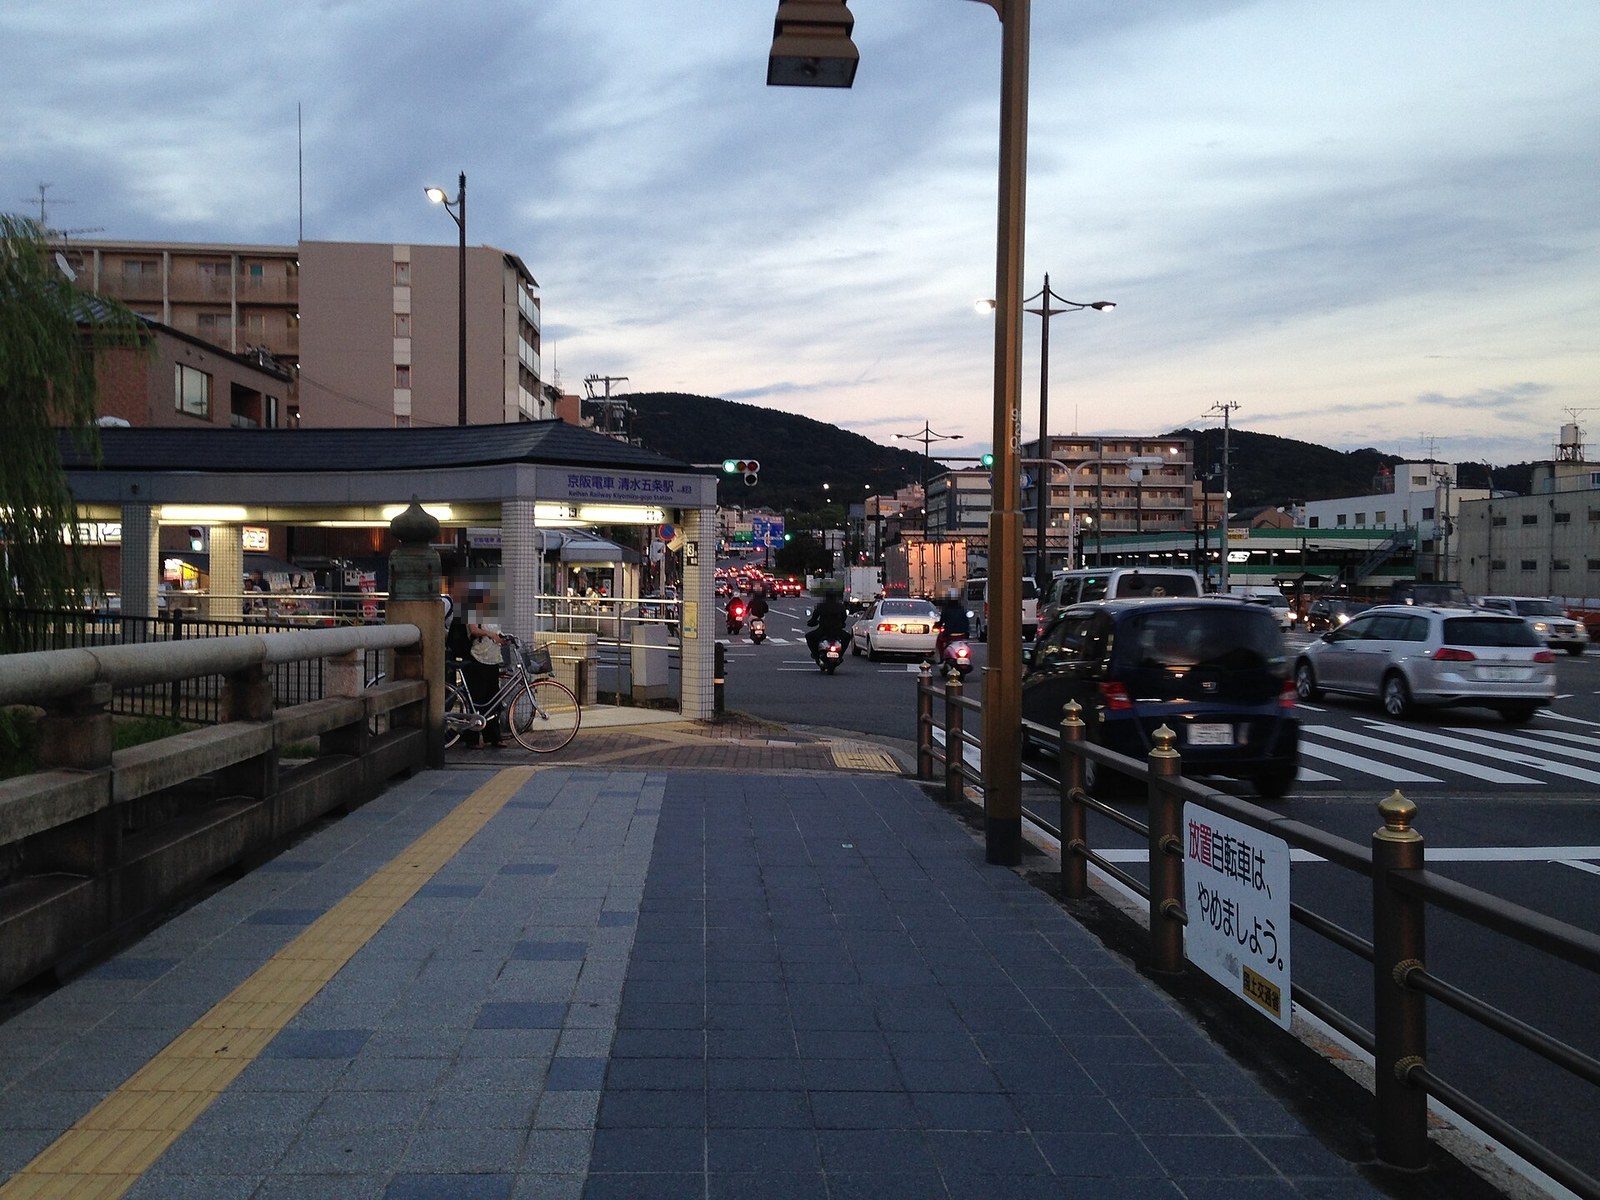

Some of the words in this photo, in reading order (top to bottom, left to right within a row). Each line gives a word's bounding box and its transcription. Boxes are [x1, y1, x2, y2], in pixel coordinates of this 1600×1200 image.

[567, 474, 615, 490] 京阪電車
[618, 477, 674, 493] 清水五条駅
[590, 491, 612, 499] Railway
[1188, 818, 1273, 900] 放置自転車は、
[1197, 881, 1285, 972] やめましょう。
